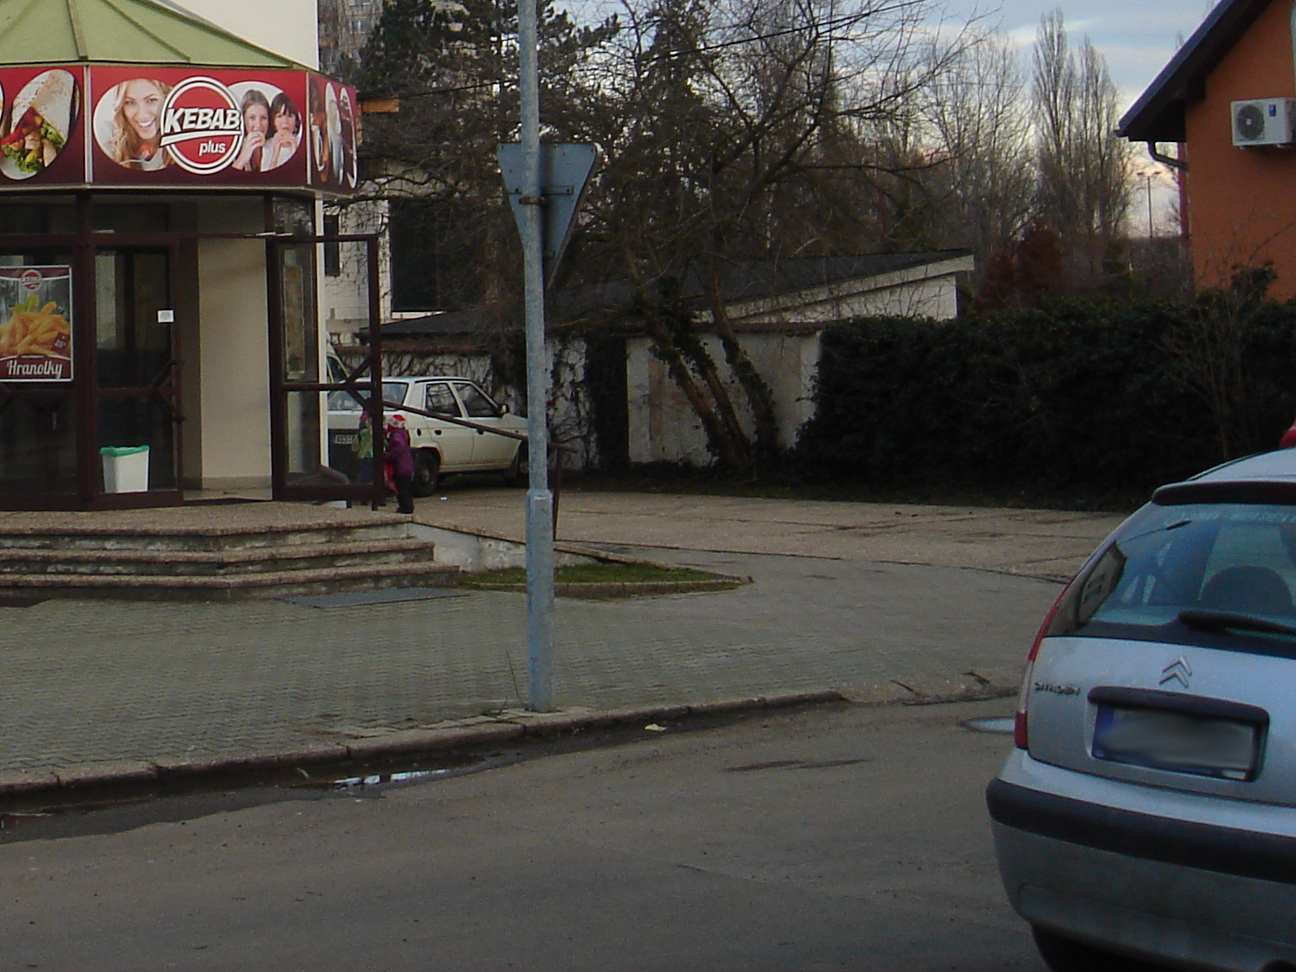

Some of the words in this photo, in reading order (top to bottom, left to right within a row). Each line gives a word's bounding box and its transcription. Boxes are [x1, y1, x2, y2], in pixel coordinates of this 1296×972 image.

[163, 107, 241, 133] KEBAB
[199, 140, 226, 157] plus
[7, 360, 63, 379] Hranolky
